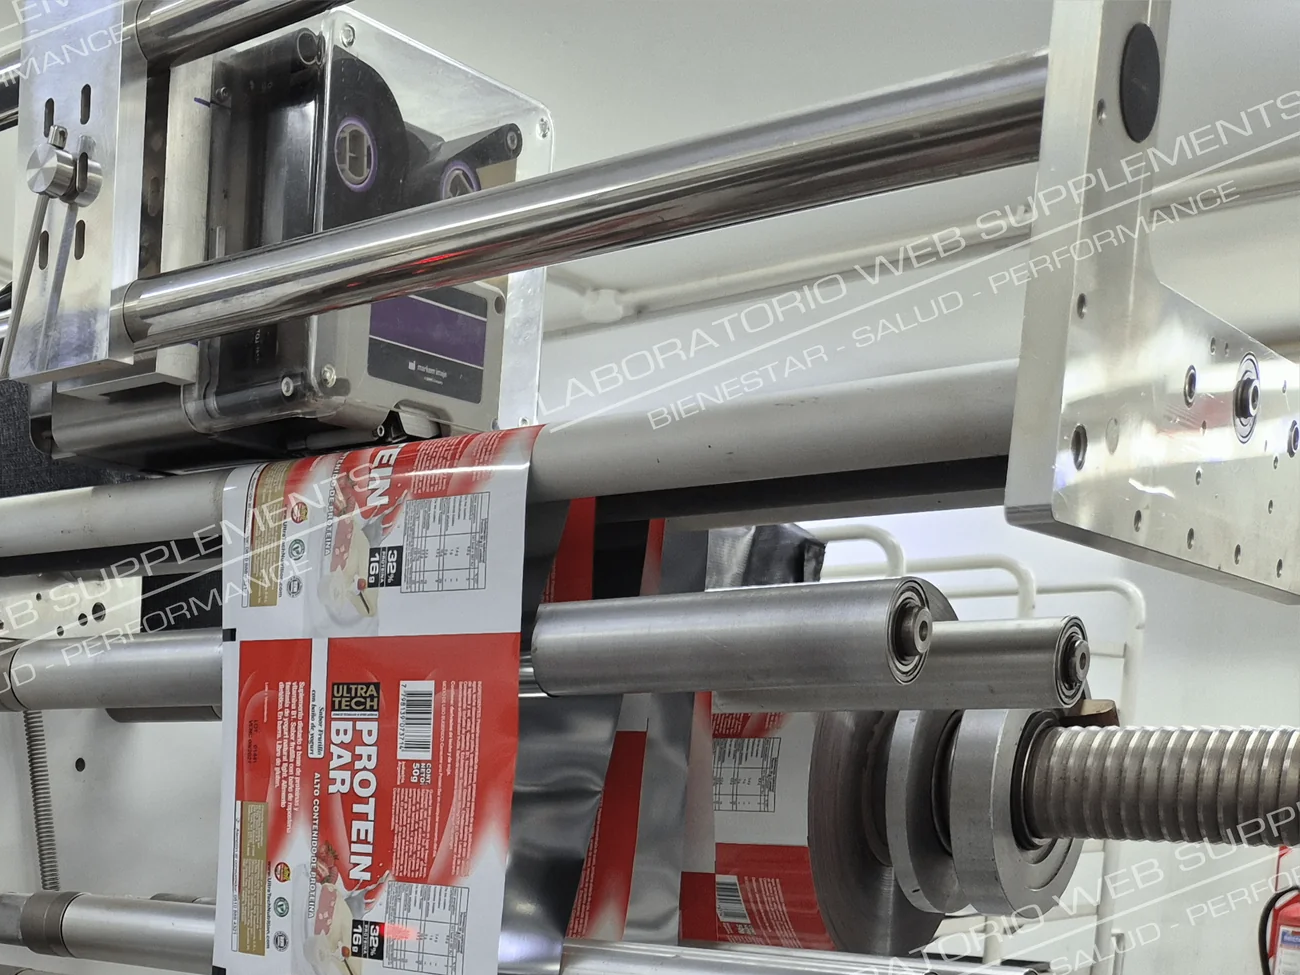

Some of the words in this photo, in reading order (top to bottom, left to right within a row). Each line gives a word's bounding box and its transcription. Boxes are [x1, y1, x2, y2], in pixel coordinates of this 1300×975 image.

[385, 549, 397, 583] 32%
[331, 697, 377, 710] TECH
[332, 684, 378, 697] ULTRA
[306, 731, 315, 755] yogurt
[326, 718, 353, 795] BAR
[410, 762, 419, 782] 50g
[348, 720, 378, 880] PROTEIN
[310, 799, 319, 853] CONTENIDO
[310, 856, 317, 868] DE
[368, 923, 379, 956] 32%
